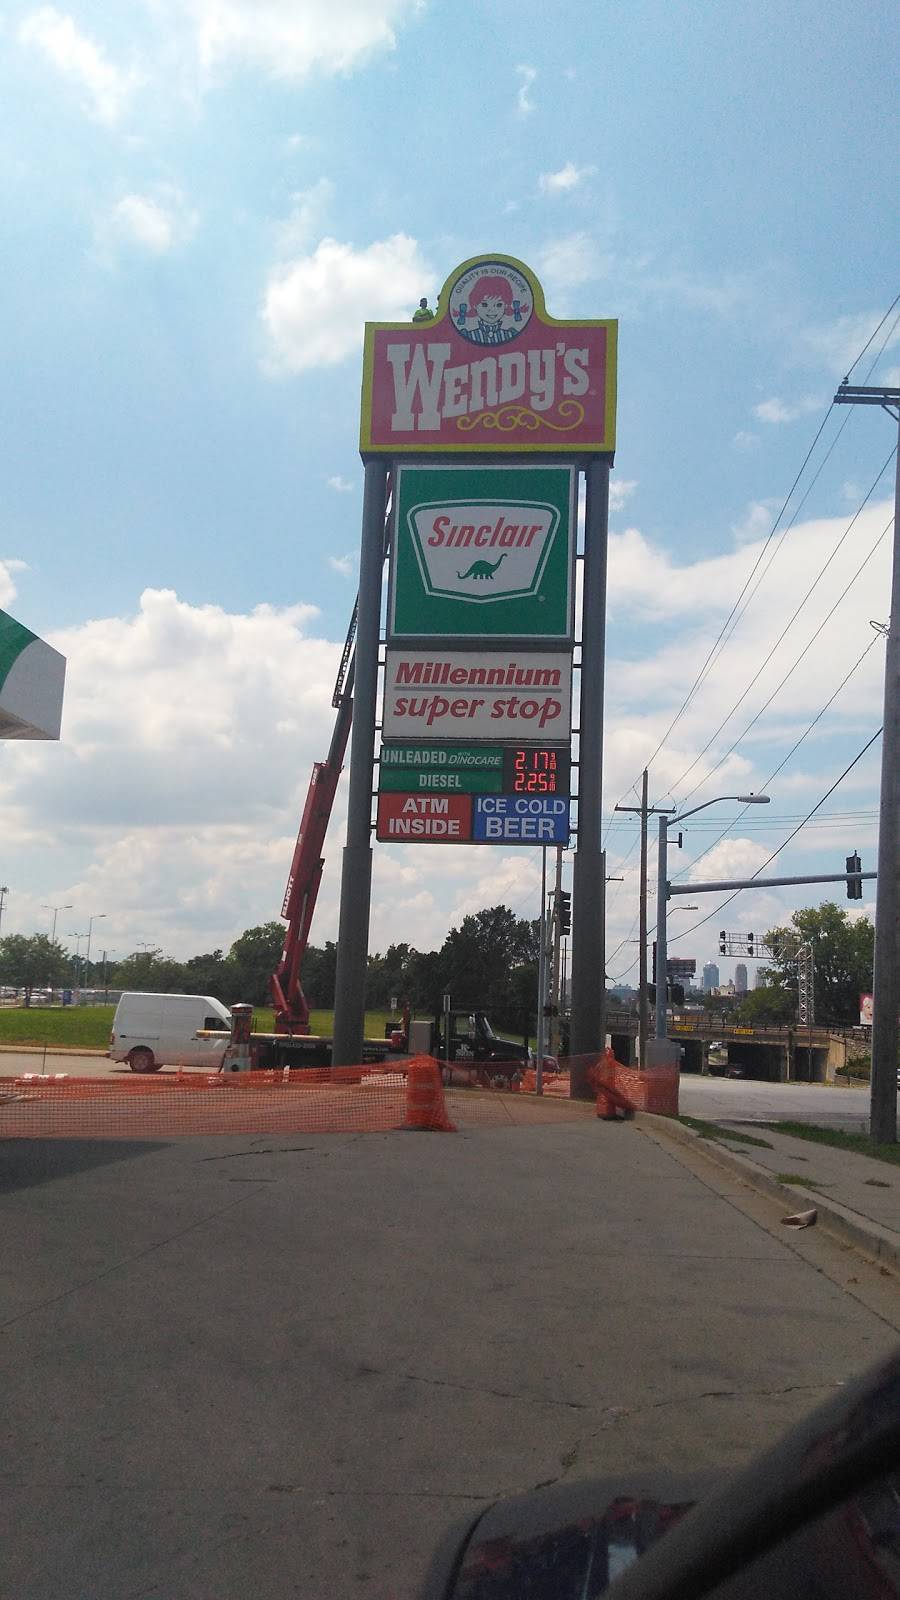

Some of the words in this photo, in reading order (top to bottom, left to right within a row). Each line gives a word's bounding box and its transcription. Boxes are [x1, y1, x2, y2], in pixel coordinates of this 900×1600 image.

[456, 271, 479, 293] QUALITY
[507, 272, 527, 293] RECIPE
[387, 343, 590, 432] Wendy's
[427, 516, 542, 547] Sinclair
[395, 662, 561, 686] Millennium
[393, 696, 484, 725] super
[491, 697, 561, 728] stop
[381, 749, 447, 764] UNLEADED
[448, 754, 502, 765] DINOCARE
[515, 751, 548, 769] 2.17
[419, 774, 462, 788] DIESEL
[515, 773, 547, 791] 2.25
[402, 798, 449, 814] ATM
[477, 798, 507, 813] ICE
[515, 798, 566, 814] COLD
[389, 818, 460, 835] INSIDE
[486, 817, 556, 838] BEER
